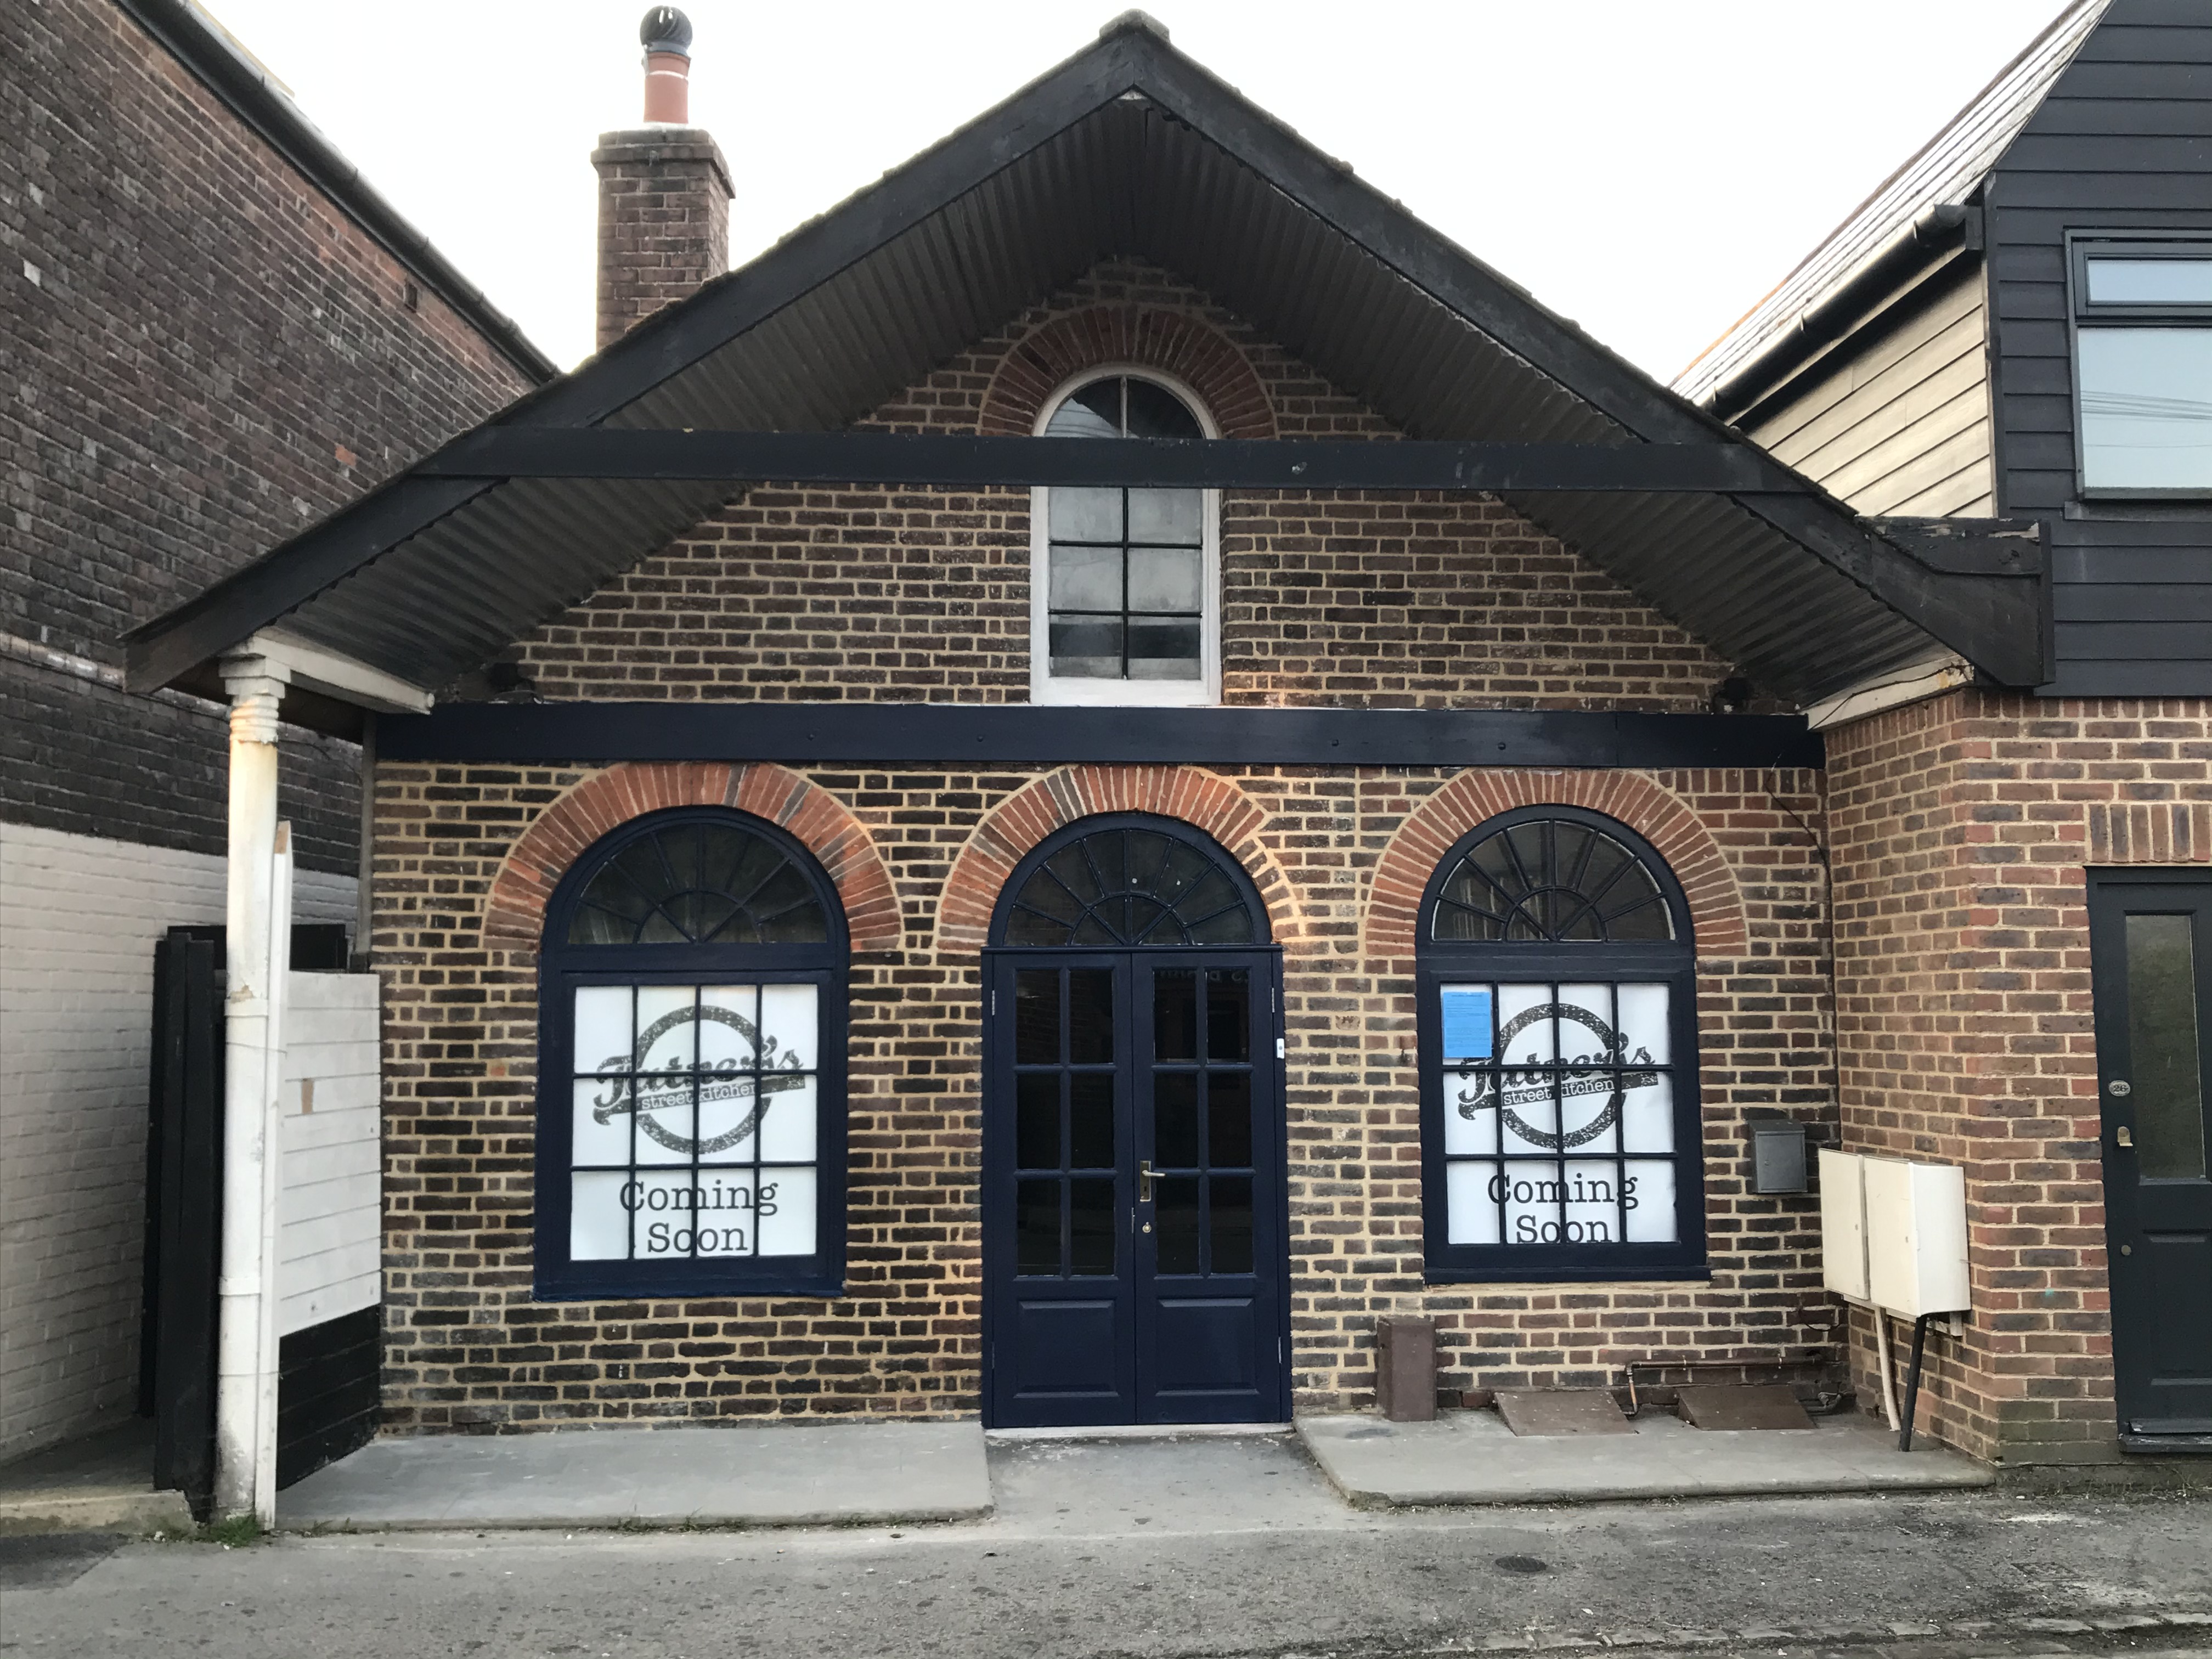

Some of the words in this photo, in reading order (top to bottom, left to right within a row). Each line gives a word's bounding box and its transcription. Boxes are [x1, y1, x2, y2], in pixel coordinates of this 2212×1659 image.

[641, 1092, 693, 1109] street
[1504, 1086, 1553, 1105] street
[1560, 1079, 1615, 1097] itchen
[619, 1179, 779, 1216] Coming
[1488, 1172, 1639, 1210] Coming
[647, 1222, 748, 1253] Soon
[1516, 1214, 1613, 1244] Soon
